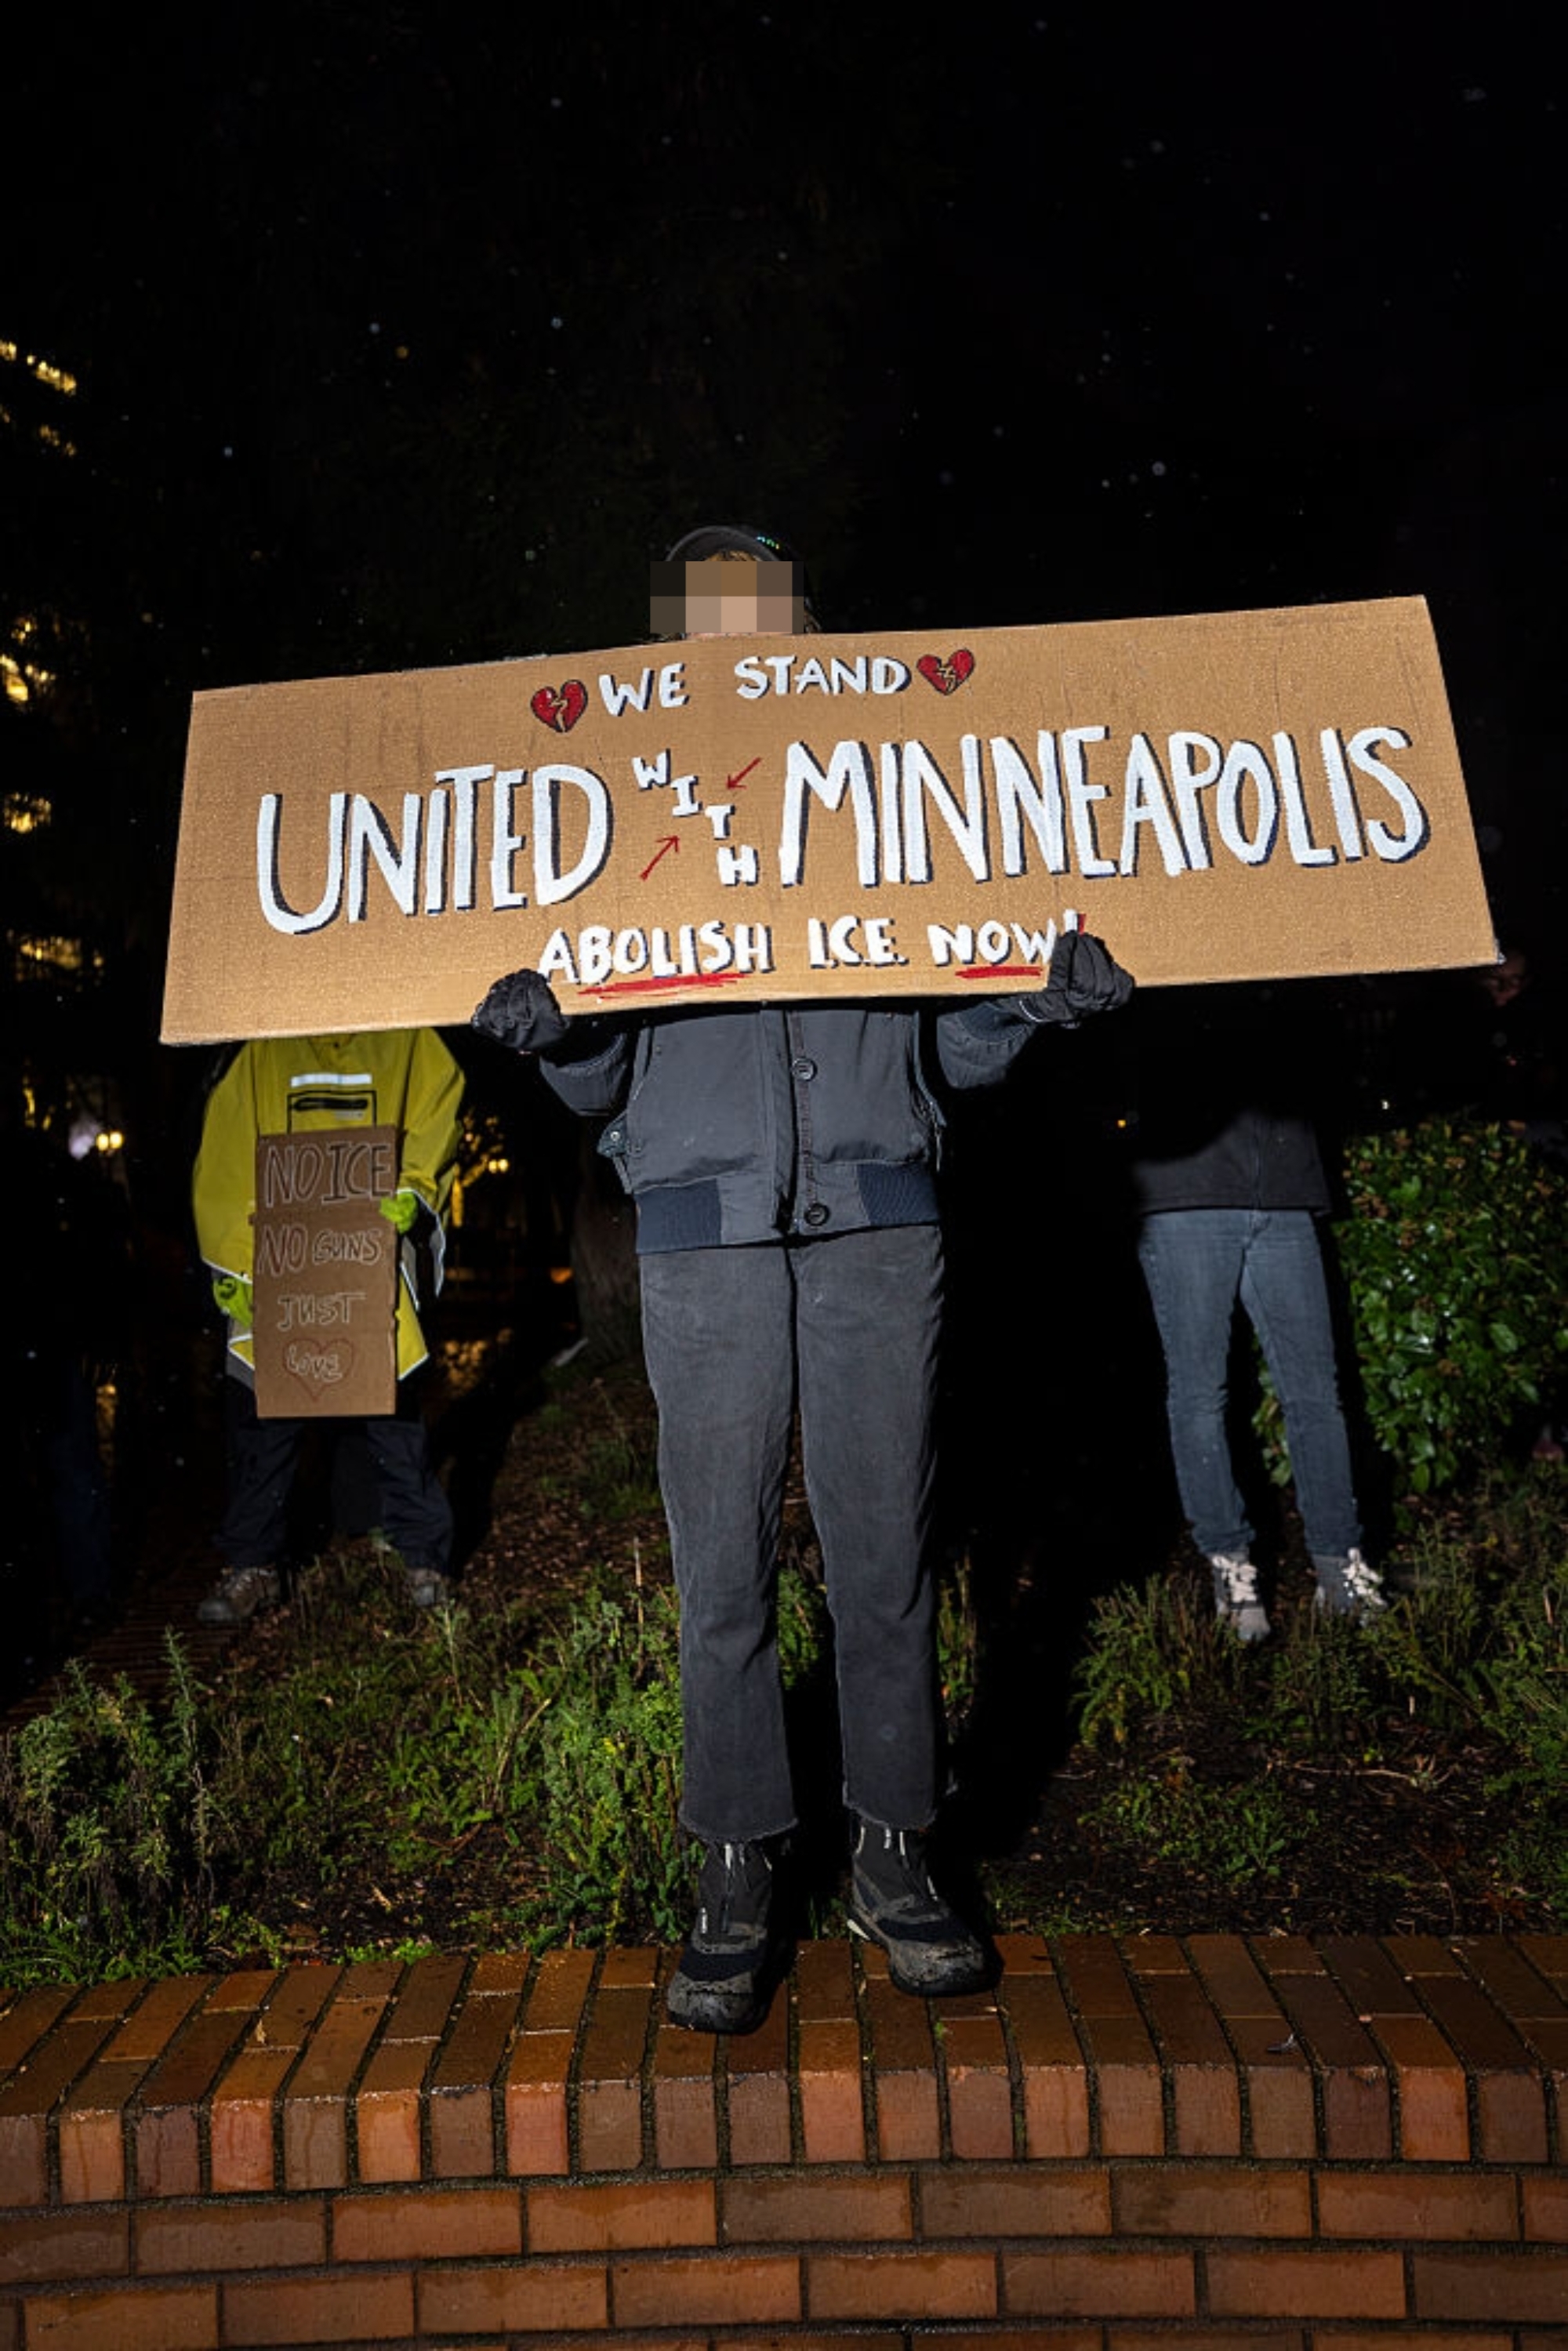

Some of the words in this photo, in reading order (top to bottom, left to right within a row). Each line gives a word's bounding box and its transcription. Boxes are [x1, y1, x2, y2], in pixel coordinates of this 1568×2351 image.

[599, 662, 689, 716] WE
[735, 655, 911, 699] STAND
[256, 764, 615, 934] UNITED
[631, 748, 759, 887] WITH
[778, 726, 1429, 887] MINNEAPOLIS
[537, 920, 775, 985] ABOLISH
[264, 1144, 323, 1208] NO
[321, 1141, 393, 1205] ICE
[257, 1223, 308, 1277] NO
[312, 1228, 383, 1265] GUNS
[277, 1292, 367, 1332] JUST
